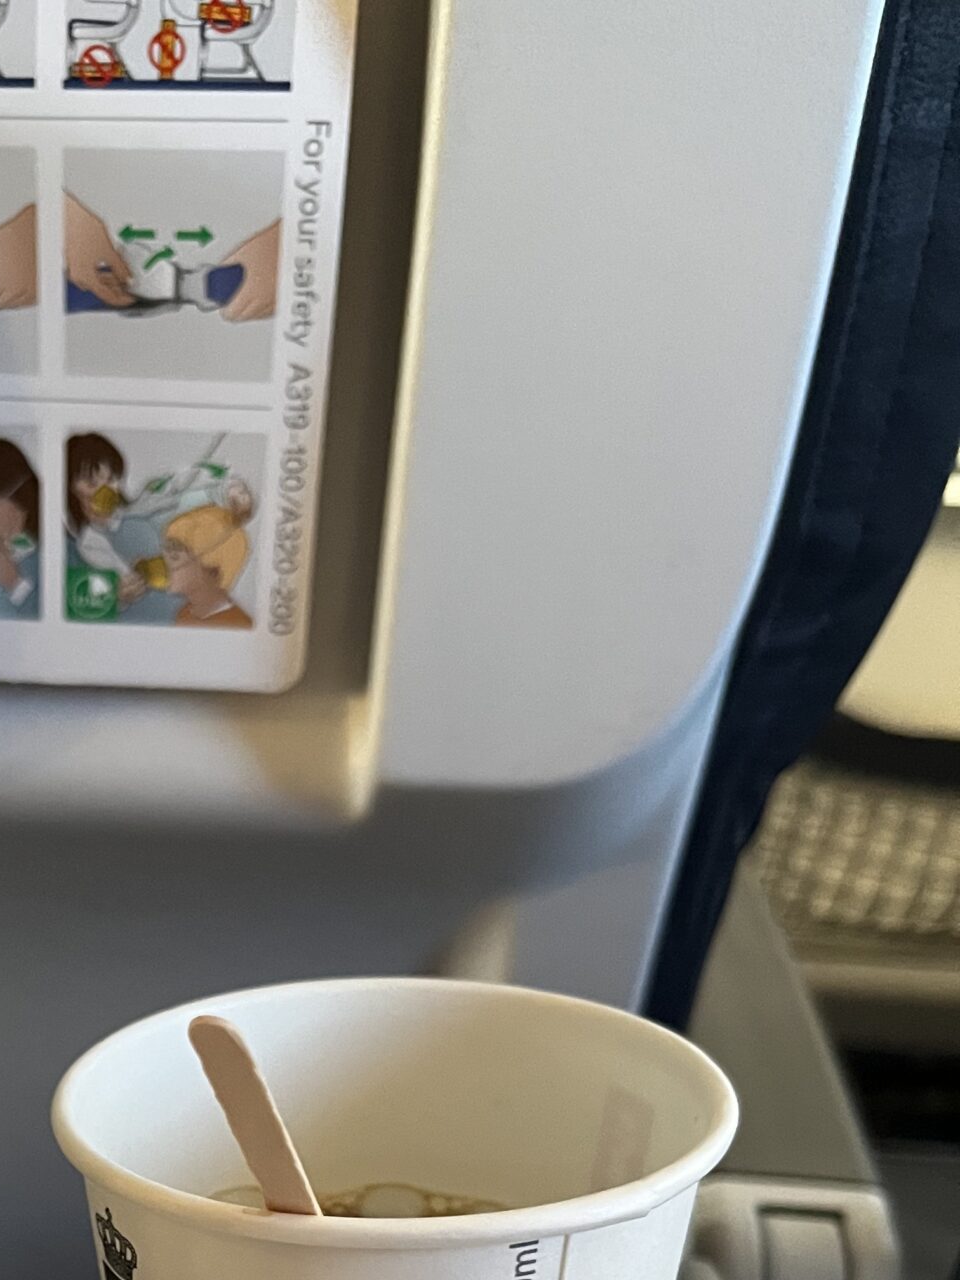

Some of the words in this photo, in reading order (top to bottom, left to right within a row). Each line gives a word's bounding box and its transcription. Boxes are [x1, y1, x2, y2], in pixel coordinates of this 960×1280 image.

[303, 120, 332, 172] For
[294, 174, 321, 249] your
[283, 256, 320, 347] safety
